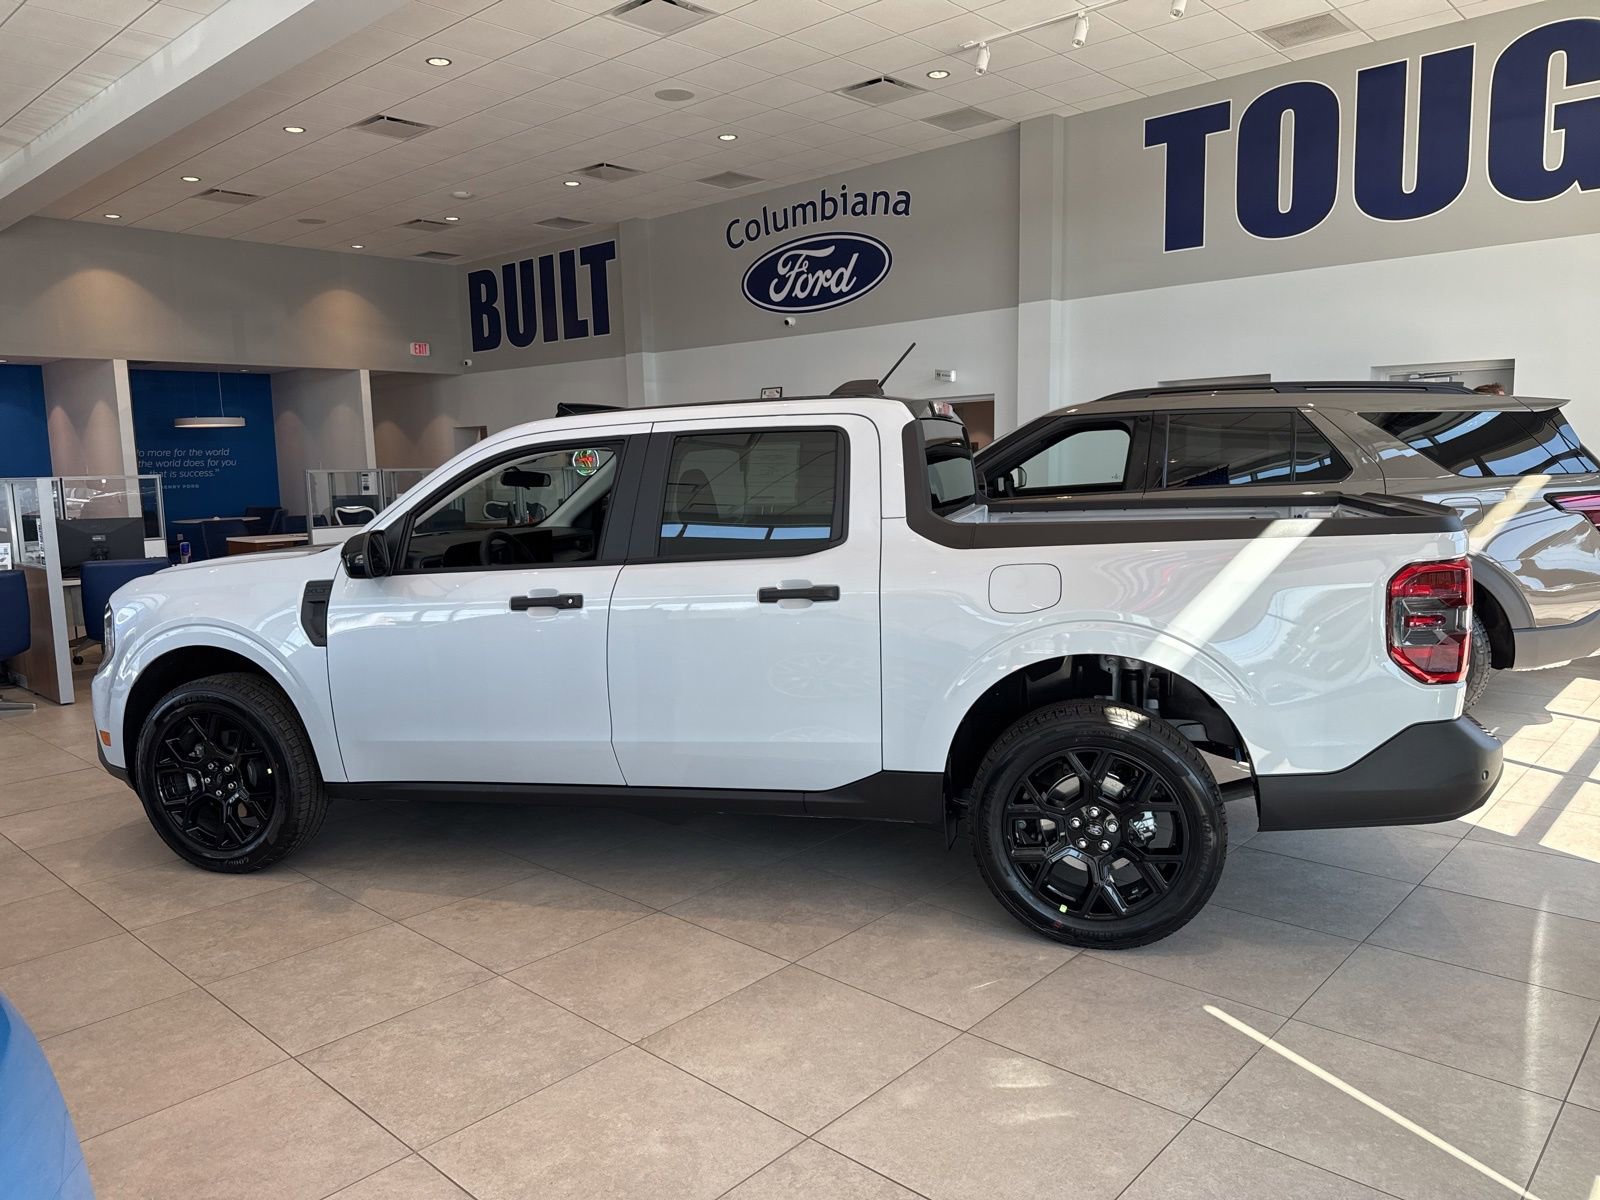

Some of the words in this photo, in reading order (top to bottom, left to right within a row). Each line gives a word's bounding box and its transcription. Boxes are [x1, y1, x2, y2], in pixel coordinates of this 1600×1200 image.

[726, 184, 911, 250] Columbiana
[768, 244, 860, 302] Ford
[467, 240, 616, 353] BUILT
[413, 343, 428, 355] EXIT
[147, 449, 171, 457] more
[174, 448, 187, 458] for
[189, 448, 203, 456] the
[205, 448, 230, 456] world
[155, 459, 181, 467] world
[183, 459, 205, 467] does
[207, 459, 219, 468] for
[221, 459, 237, 468] you
[169, 469, 177, 478] is
